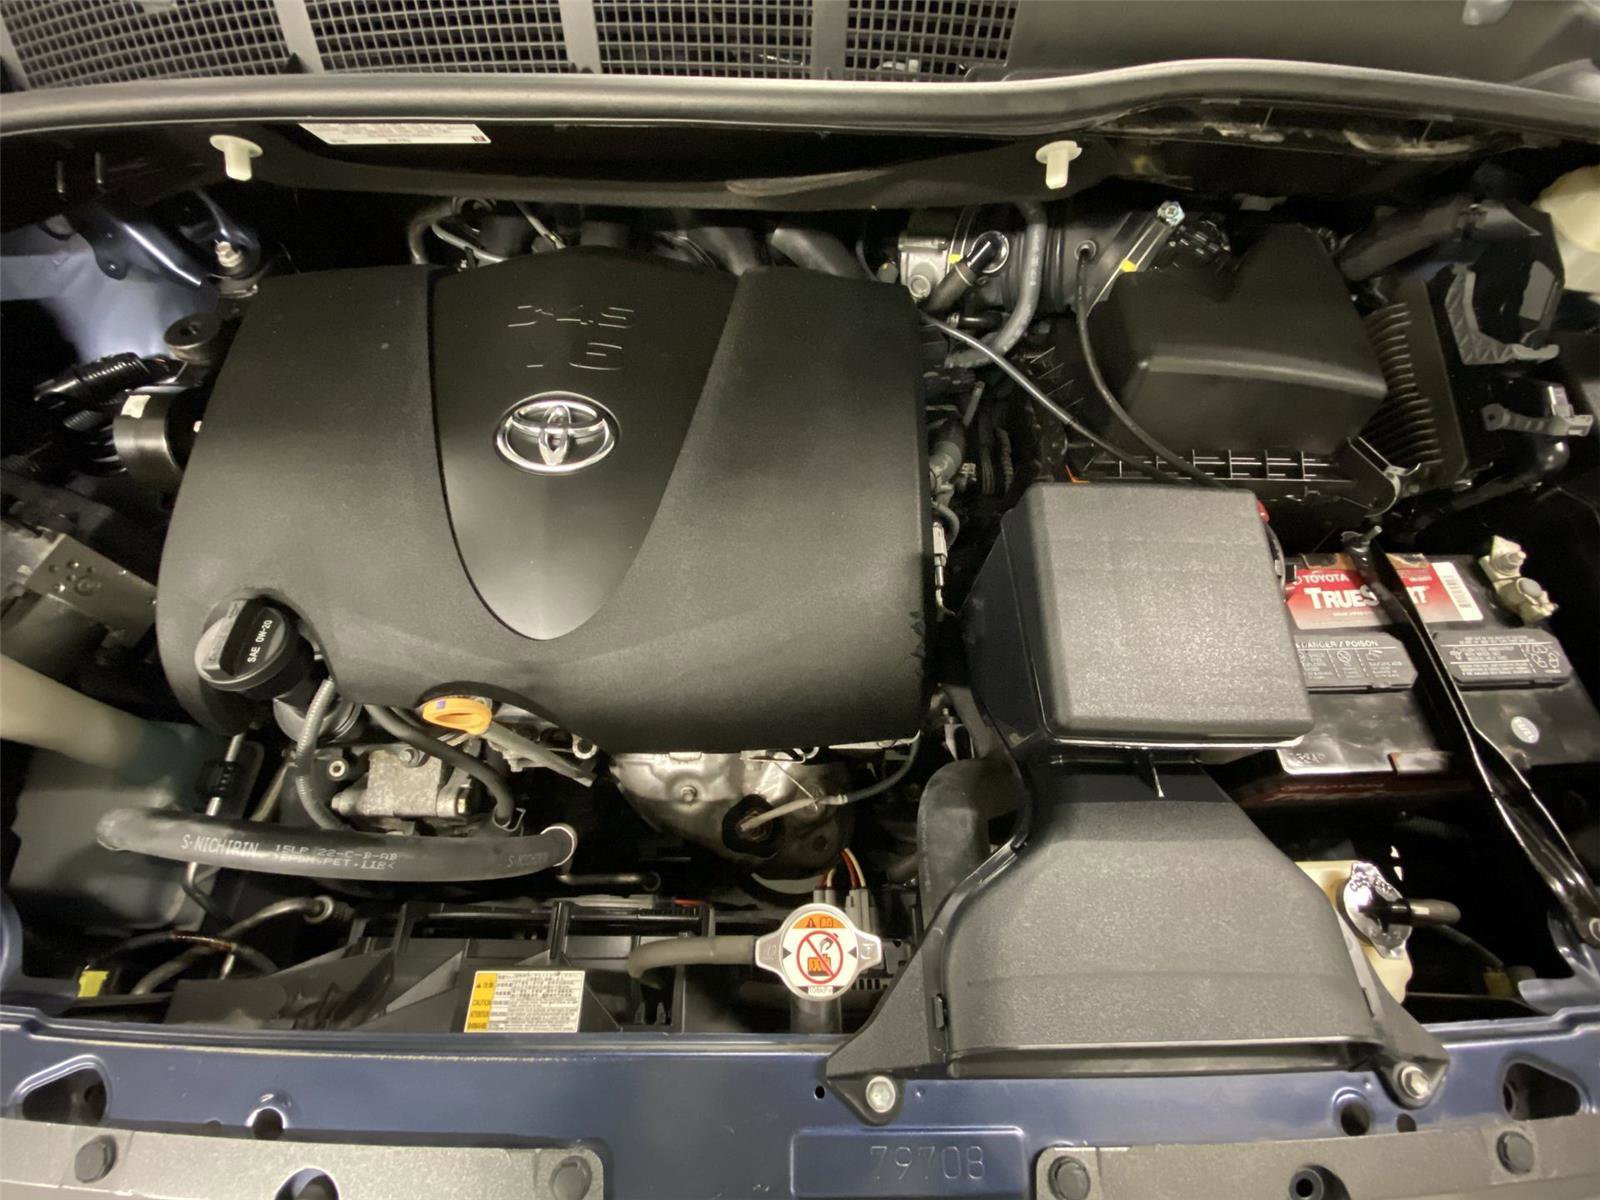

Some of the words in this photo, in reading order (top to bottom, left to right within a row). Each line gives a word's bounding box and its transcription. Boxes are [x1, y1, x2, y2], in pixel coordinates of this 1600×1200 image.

[1303, 574, 1350, 583] TOYOTA
[247, 646, 261, 663] SAE
[255, 620, 273, 643] 0W-20
[870, 1145, 986, 1180] 79708
